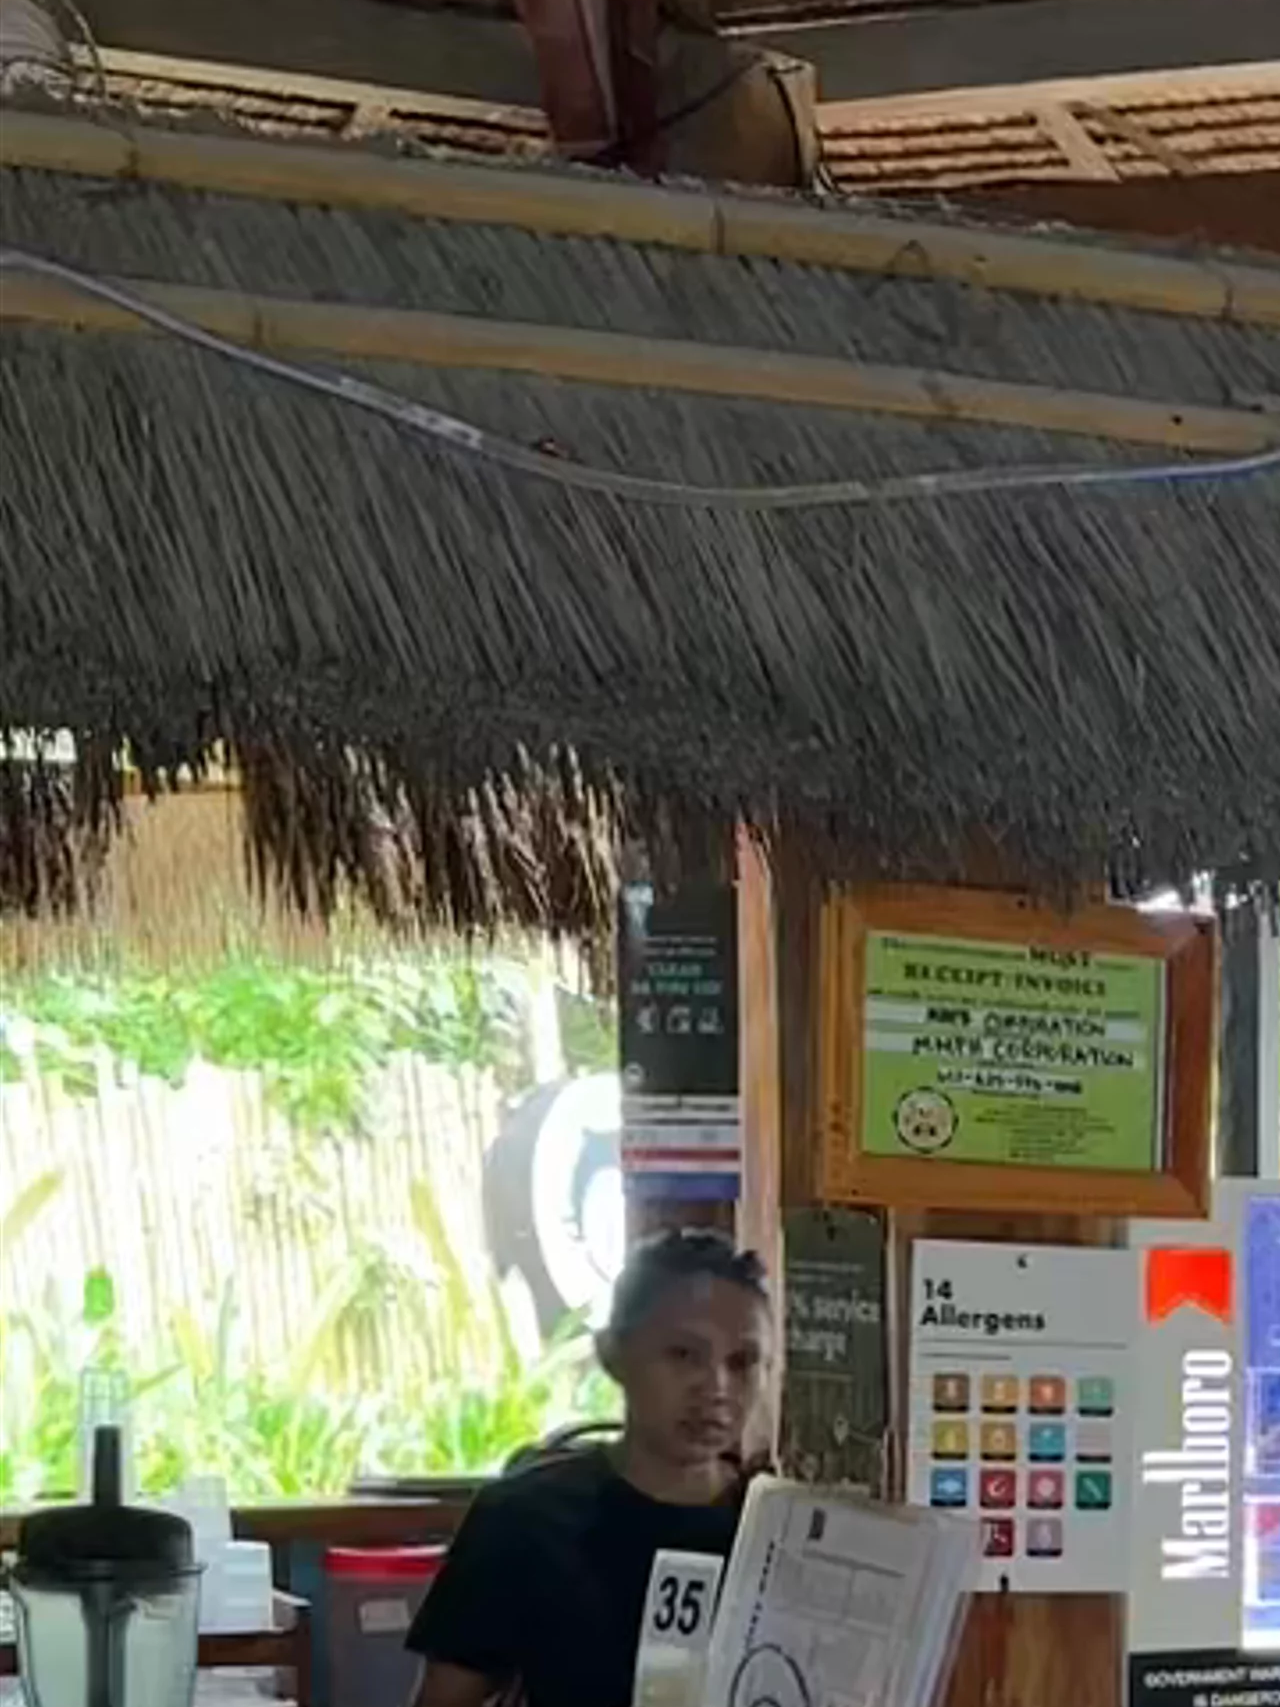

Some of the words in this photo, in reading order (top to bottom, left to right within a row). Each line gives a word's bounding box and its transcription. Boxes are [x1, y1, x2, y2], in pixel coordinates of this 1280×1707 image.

[923, 1277, 953, 1301] 14
[920, 1305, 1046, 1335] Allergens
[1142, 1349, 1233, 1580] Marlboro
[653, 1575, 706, 1636] 35
[1143, 1665, 1248, 1689] GOVERNMENT
